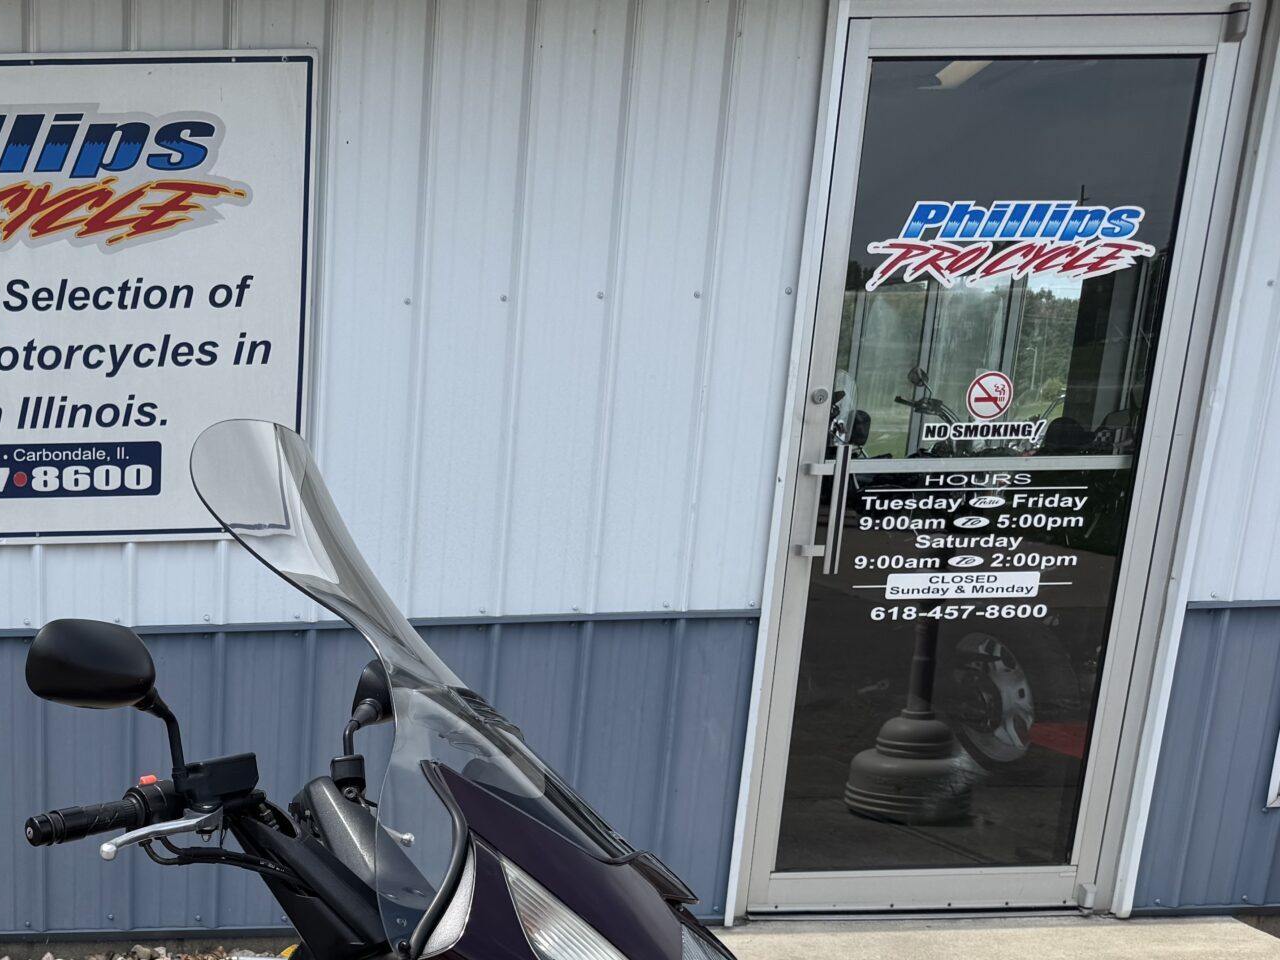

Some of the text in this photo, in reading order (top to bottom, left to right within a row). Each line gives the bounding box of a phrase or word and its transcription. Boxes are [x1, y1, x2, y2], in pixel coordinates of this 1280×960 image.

[902, 202, 1142, 241] Phillips
[869, 240, 1152, 289] PRO CYCLE
[3, 278, 195, 312] Selection
[208, 276, 254, 308] of
[234, 333, 272, 365] in
[17, 395, 169, 430] Illinois.
[924, 421, 1046, 440] NO SMOKING!
[13, 446, 110, 463] Carbondale,
[924, 473, 1032, 487] HOURS
[862, 495, 963, 513] Tuesday
[1012, 493, 1088, 511] Friday
[859, 515, 946, 531] 9:00am
[996, 514, 1084, 531] 5:00pm
[915, 533, 1023, 551] Saturday
[854, 555, 941, 570] 9:00am
[990, 553, 1078, 569] 2:00pm
[928, 574, 998, 585] CLOSED
[889, 584, 1034, 598] Sunday & Monday
[869, 603, 1048, 622] 618-457-8600
